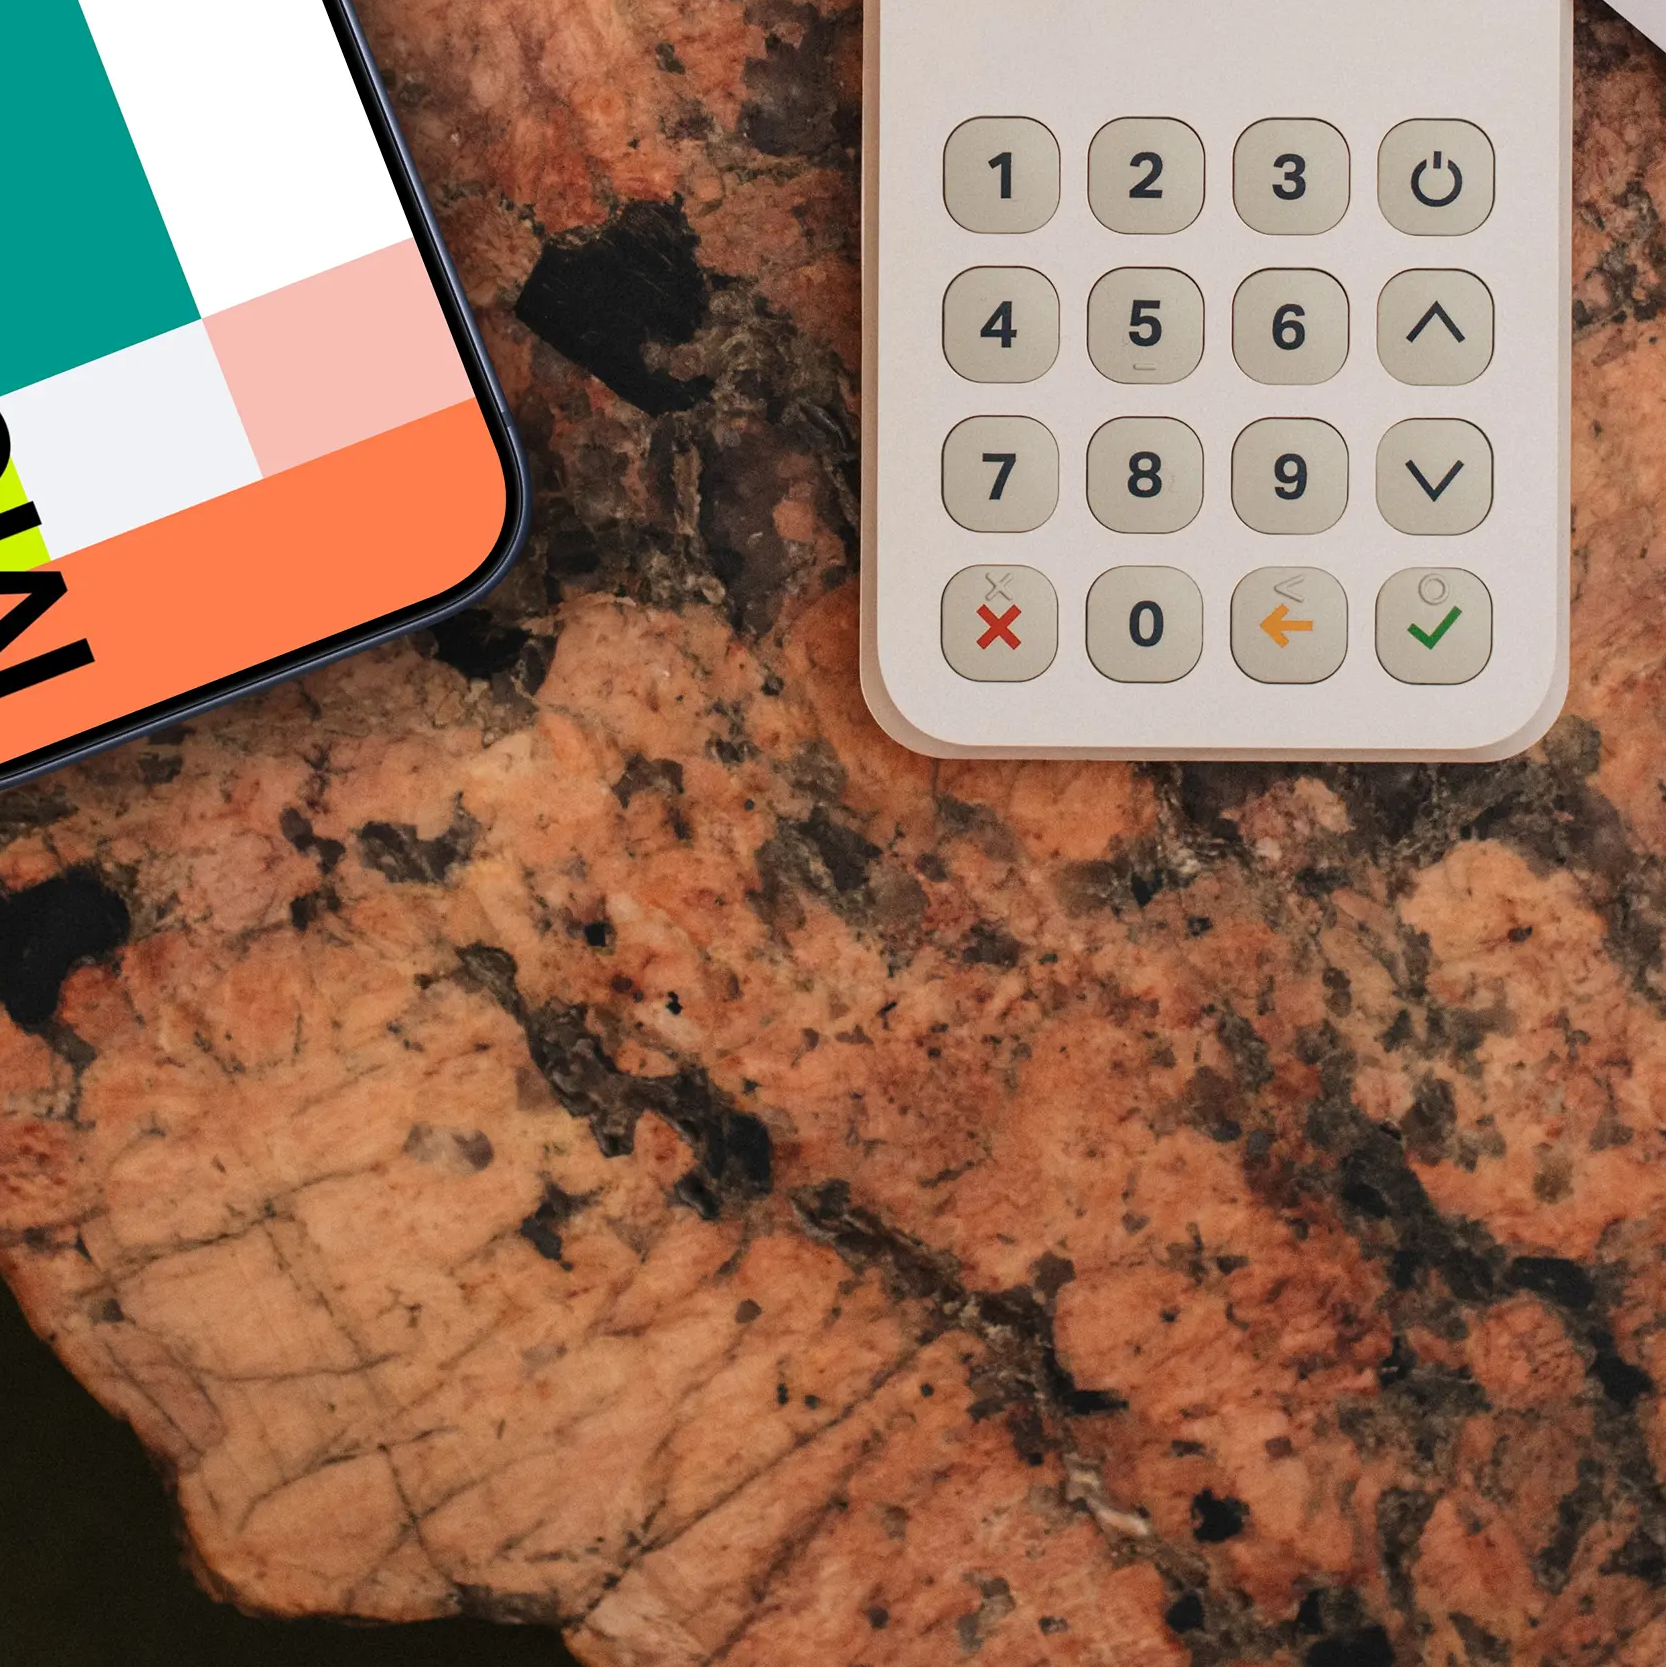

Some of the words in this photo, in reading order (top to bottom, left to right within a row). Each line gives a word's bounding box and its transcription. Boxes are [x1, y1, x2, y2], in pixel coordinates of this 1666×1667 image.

[988, 151, 1013, 200] 1
[1128, 150, 1164, 200] 2
[1271, 152, 1308, 202] 3
[979, 300, 1019, 349] 4
[1127, 299, 1163, 348] 5
[1271, 302, 1307, 352] 6
[981, 452, 1017, 502] 7
[1126, 450, 1164, 499] 8
[1273, 452, 1309, 502] 9
[1128, 599, 1165, 649] 0
